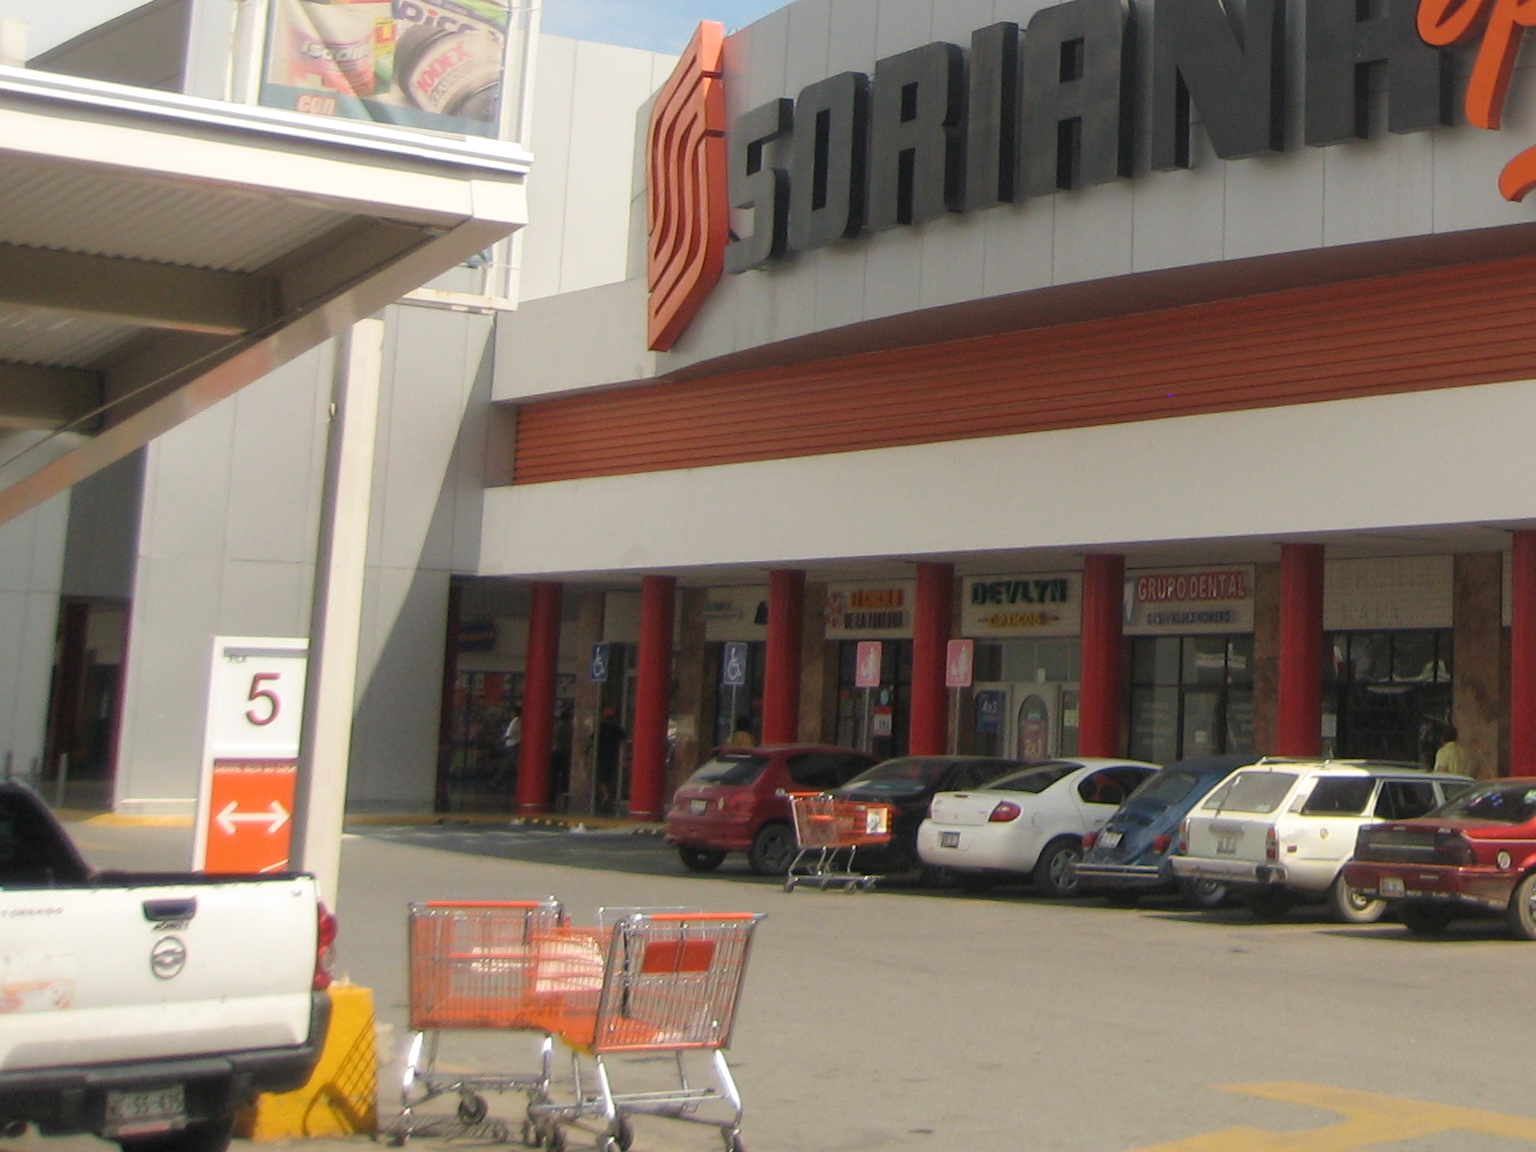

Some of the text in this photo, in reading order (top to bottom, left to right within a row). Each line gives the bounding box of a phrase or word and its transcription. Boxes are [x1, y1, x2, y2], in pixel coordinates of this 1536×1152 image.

[971, 579, 1068, 606] DEVLYN
[1137, 571, 1247, 602] GRUPO DENTAL
[245, 672, 282, 726] 5
